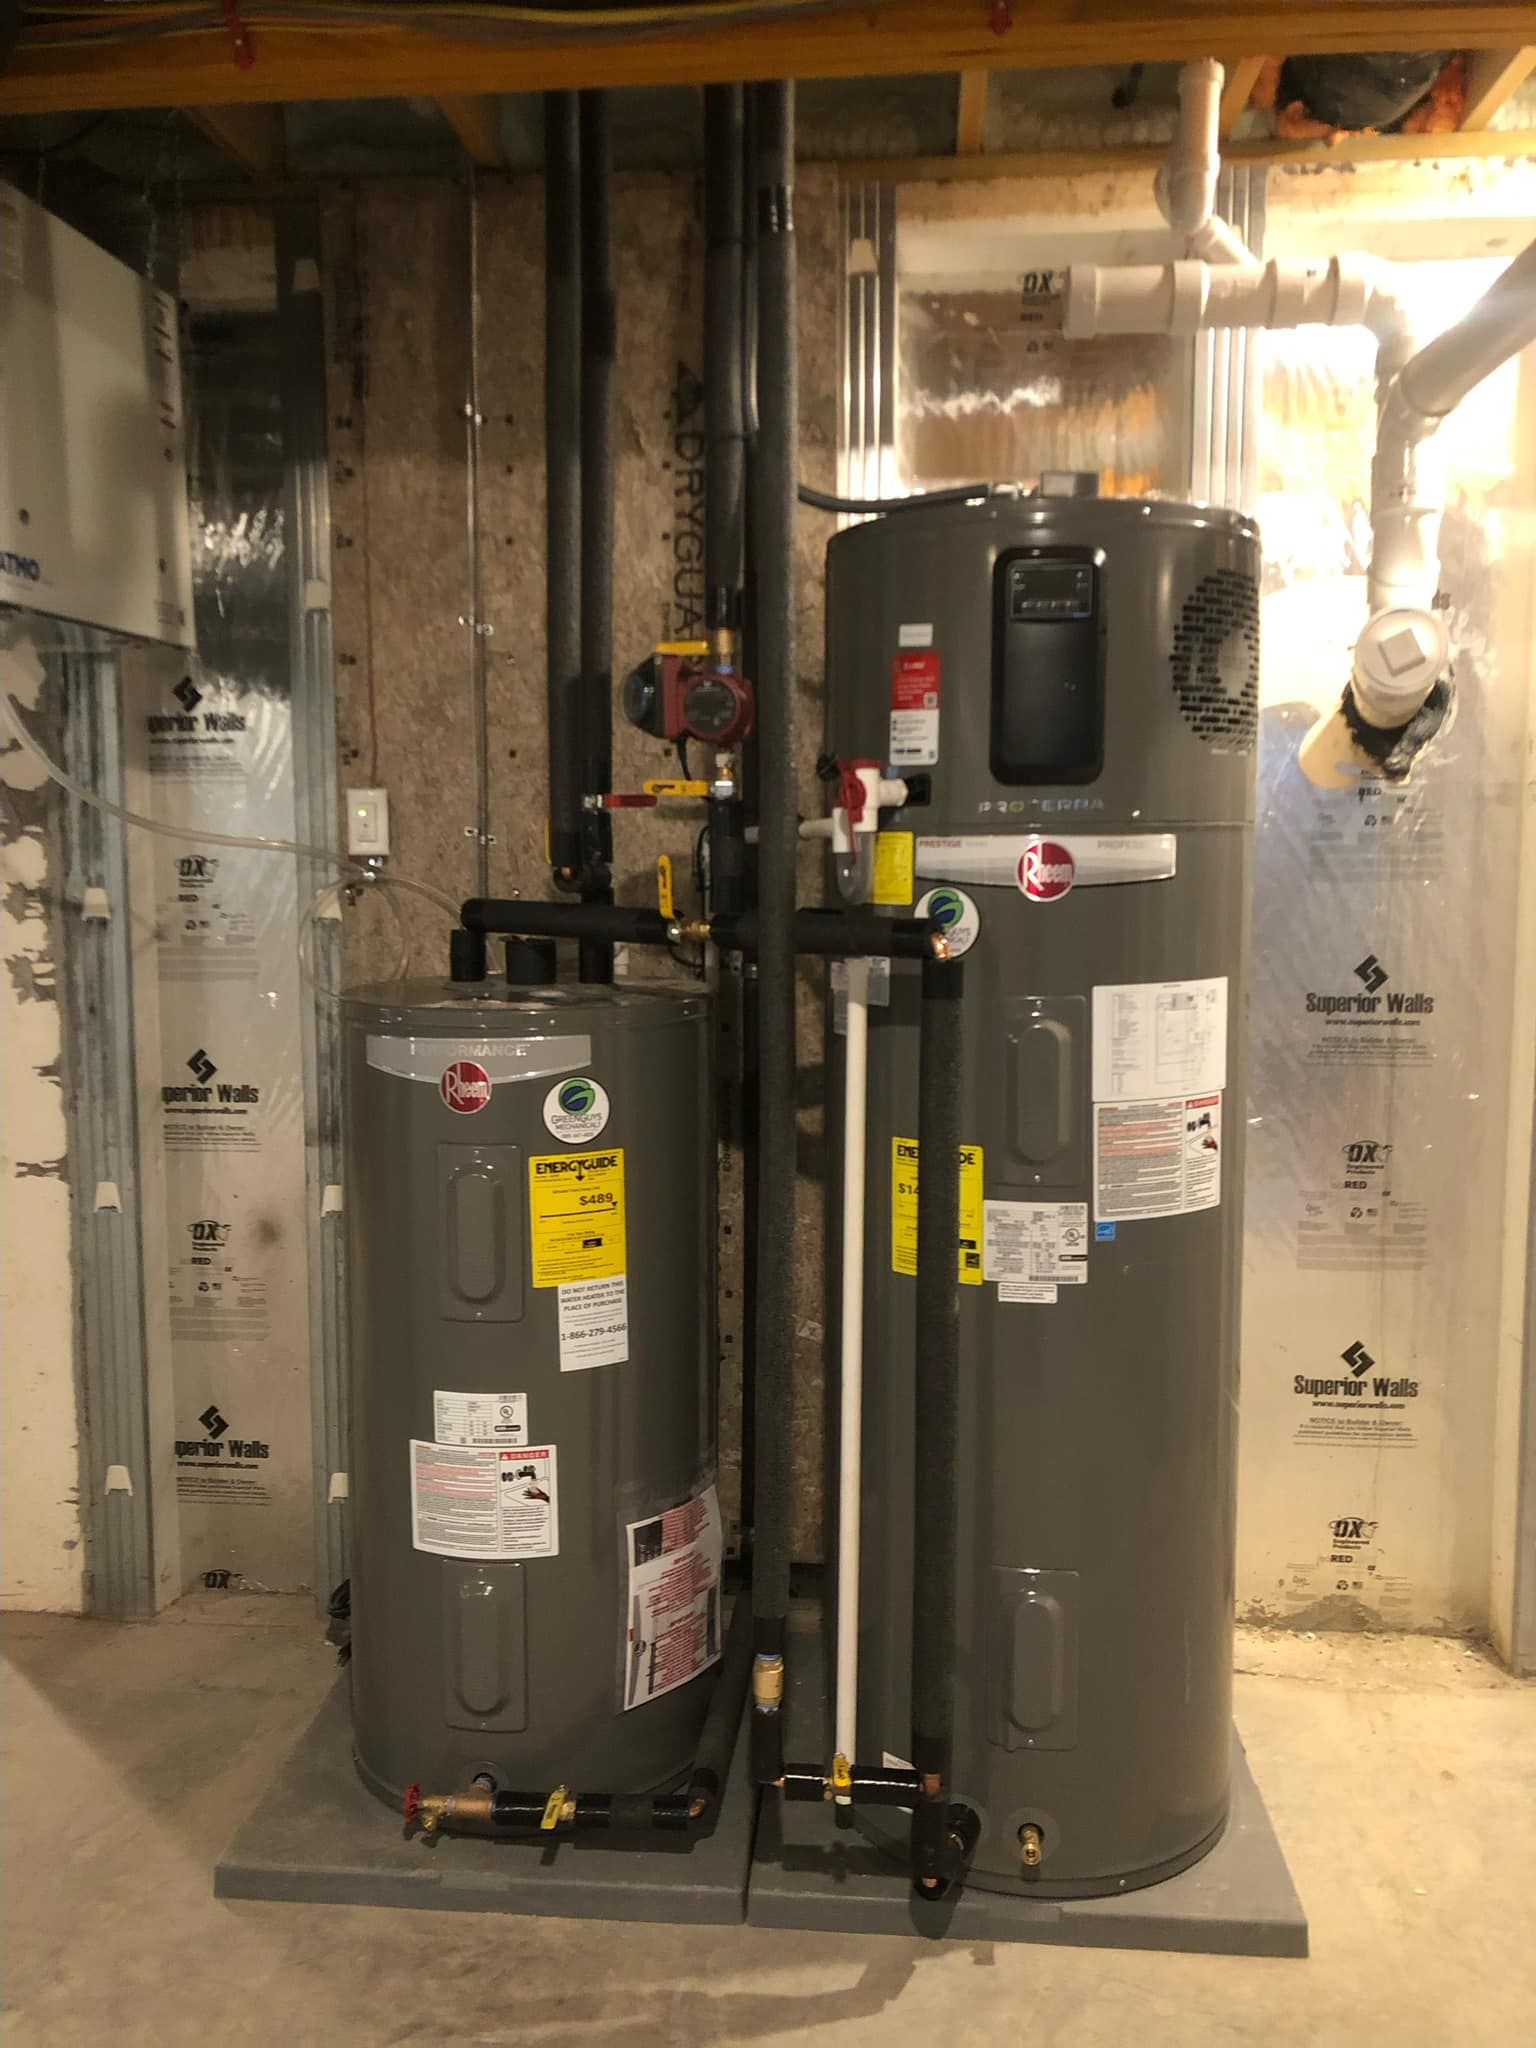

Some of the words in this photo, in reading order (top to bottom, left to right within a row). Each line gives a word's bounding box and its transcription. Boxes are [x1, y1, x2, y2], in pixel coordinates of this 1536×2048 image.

[1022, 840, 1072, 891] Rheem
[1305, 992, 1381, 1016] Superior
[1386, 992, 1434, 1014] Walls
[216, 1084, 259, 1103] Walls
[446, 1063, 489, 1105] Rheem
[1348, 1143, 1377, 1162] OX
[1344, 1180, 1368, 1189] RED
[192, 1223, 218, 1241] OX
[1294, 1374, 1368, 1398] Superior
[1372, 1377, 1419, 1398] Walls
[175, 1439, 225, 1459] perior
[228, 1440, 270, 1459] Walls
[1333, 1519, 1363, 1538] OX
[1330, 1554, 1354, 1563] RED
[203, 1572, 230, 1589] OX
